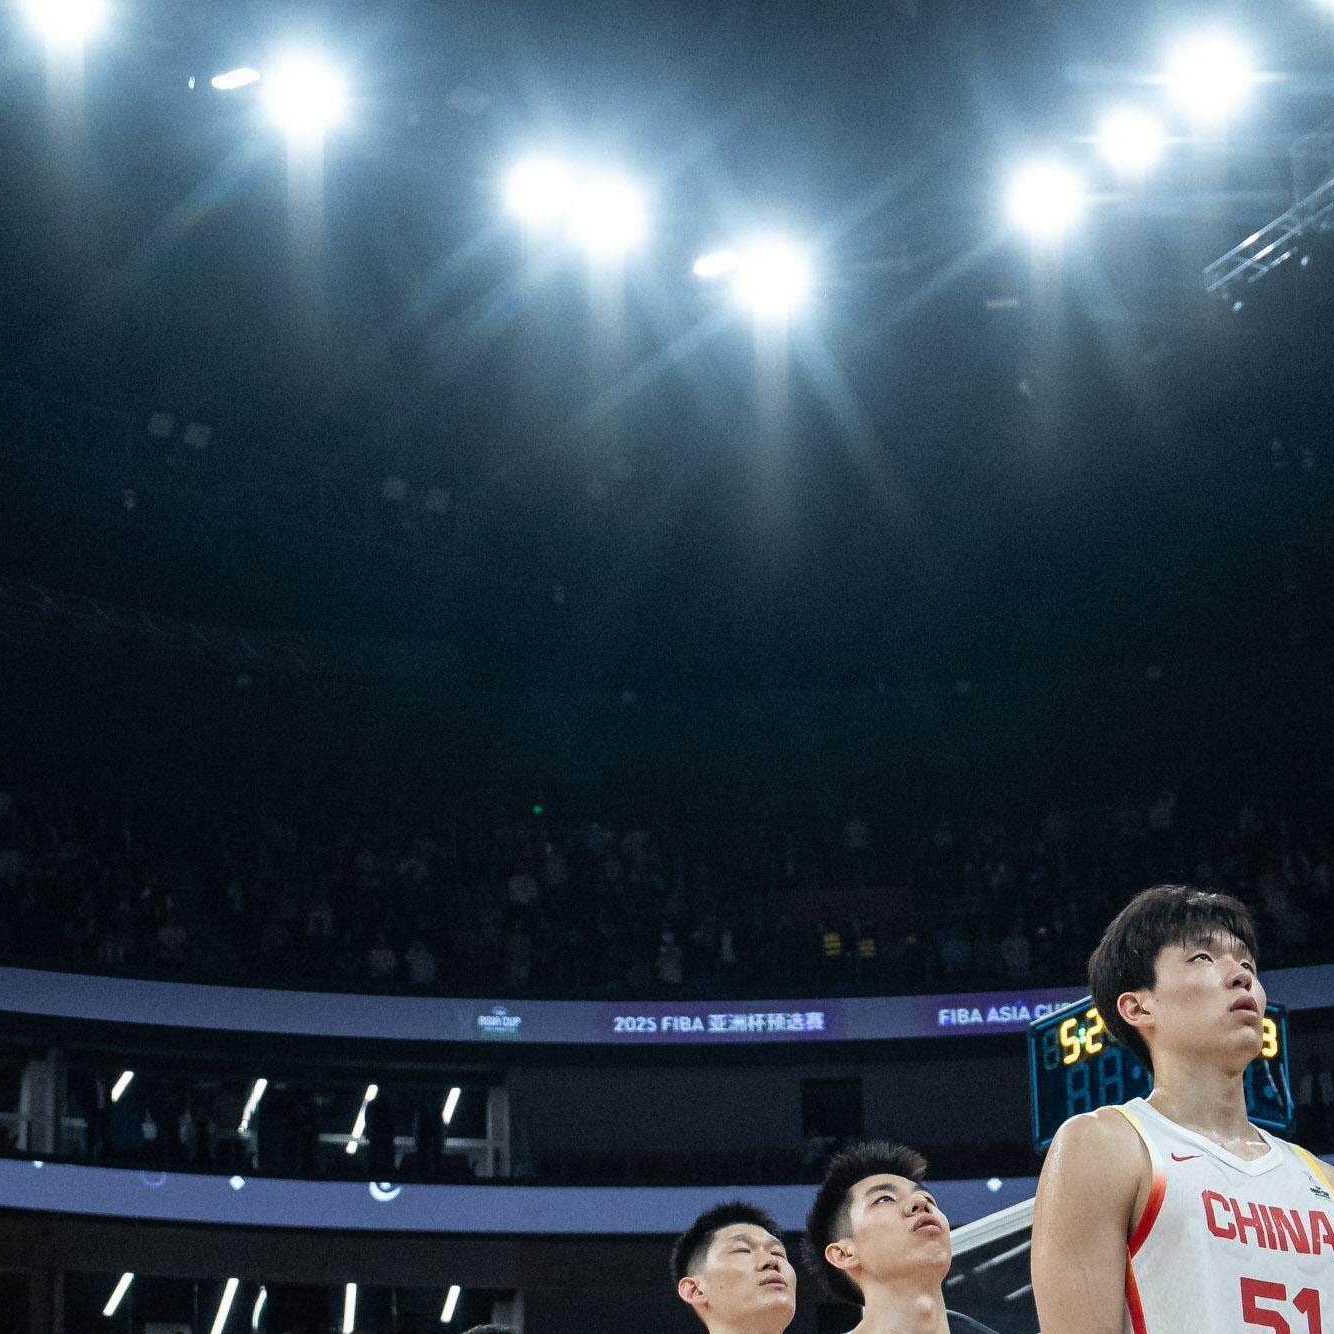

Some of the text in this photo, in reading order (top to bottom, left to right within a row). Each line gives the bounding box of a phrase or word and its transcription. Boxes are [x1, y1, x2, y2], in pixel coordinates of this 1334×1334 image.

[613, 1011, 827, 1033] 2025 FIBA 亚洲杯预选赛
[938, 1007, 983, 1026] FIBA
[986, 1004, 1032, 1024] ASIA
